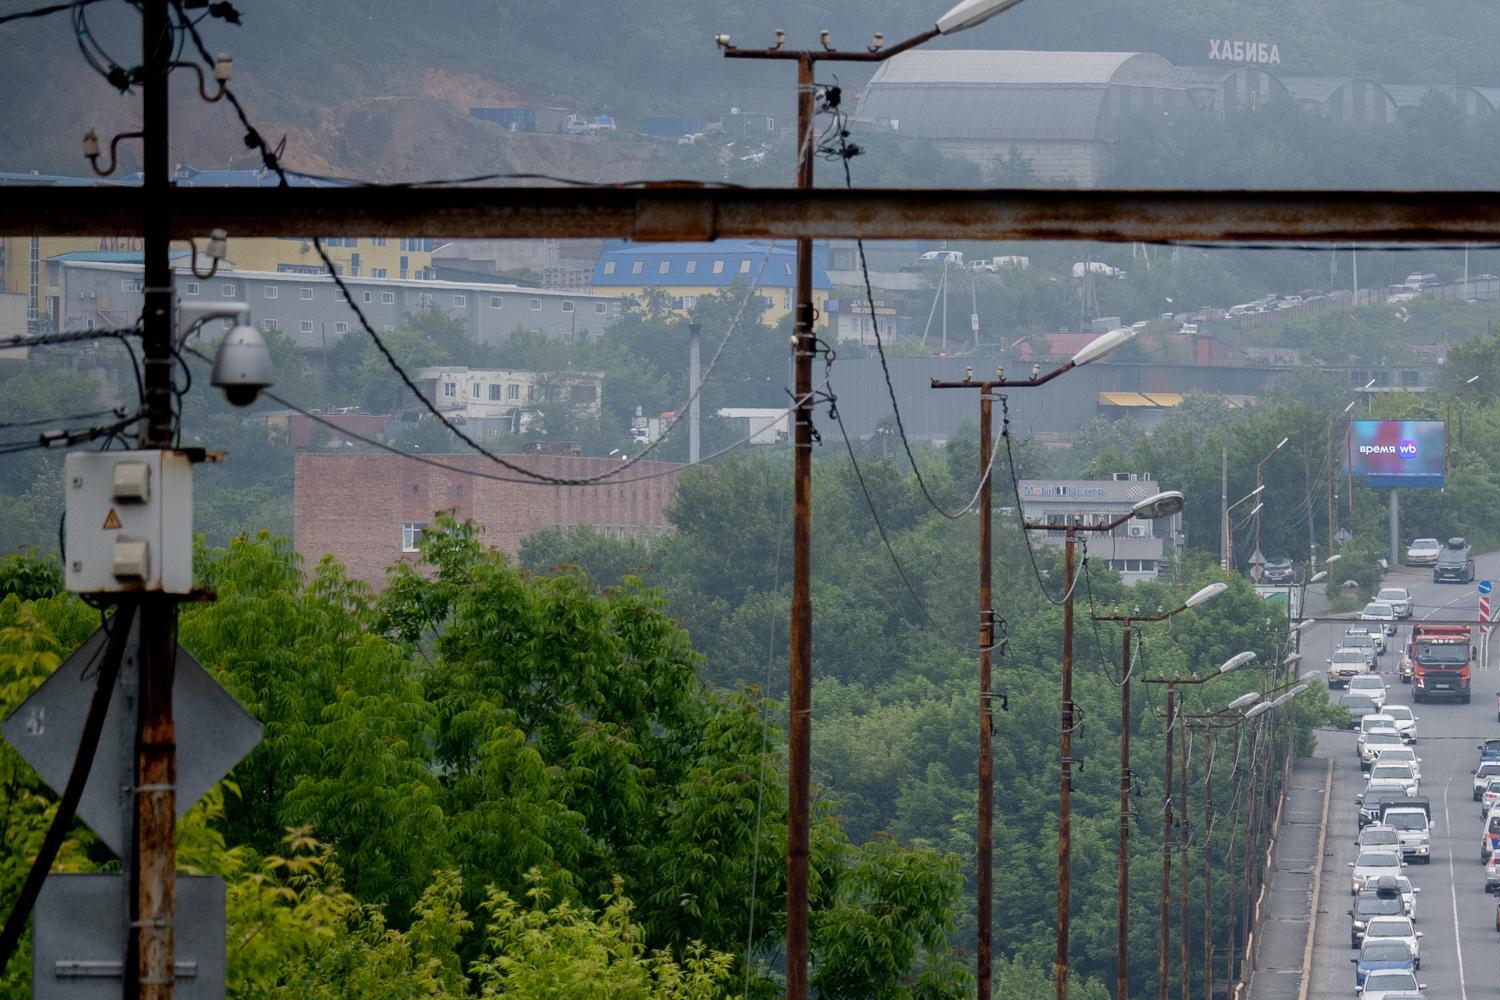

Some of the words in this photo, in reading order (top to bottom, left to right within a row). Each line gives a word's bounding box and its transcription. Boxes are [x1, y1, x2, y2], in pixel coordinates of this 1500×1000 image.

[1209, 39, 1280, 64] ХАБИБА
[1359, 445, 1396, 455] время
[1400, 443, 1417, 454] wb
